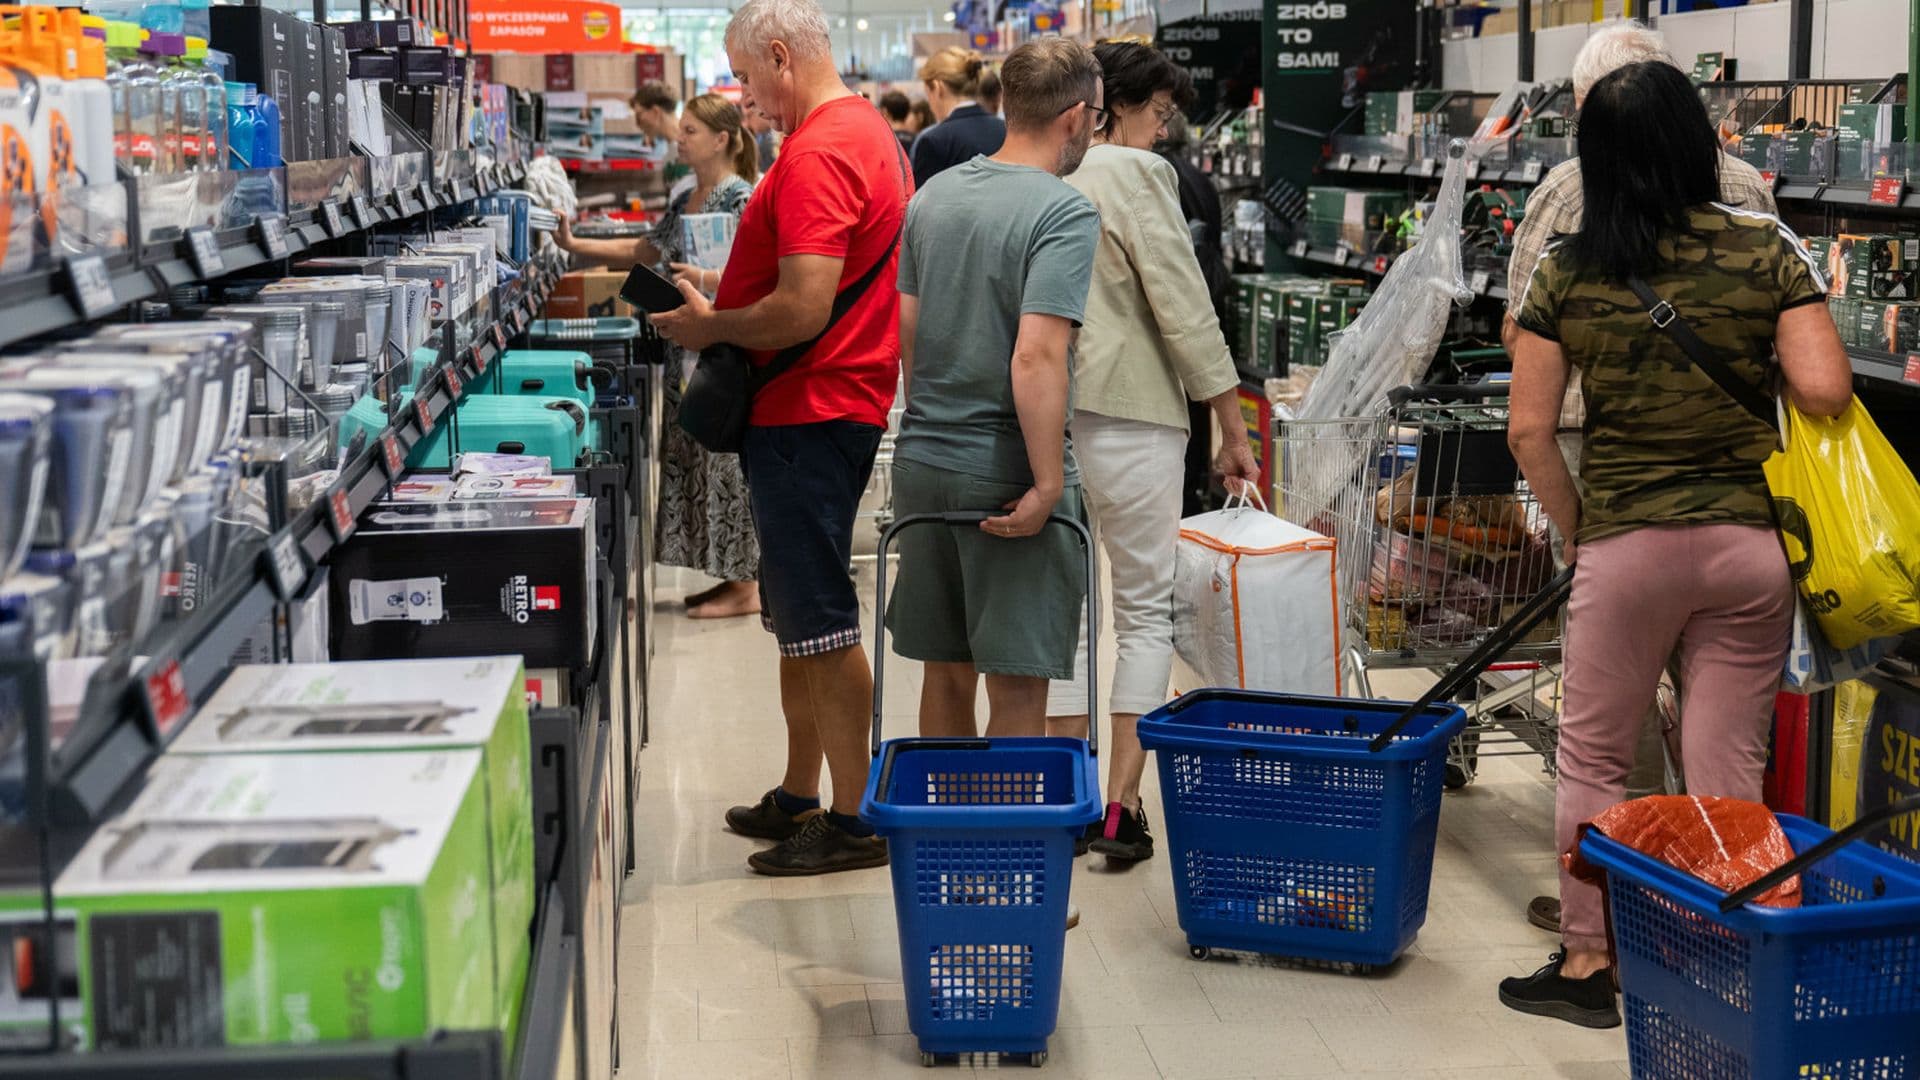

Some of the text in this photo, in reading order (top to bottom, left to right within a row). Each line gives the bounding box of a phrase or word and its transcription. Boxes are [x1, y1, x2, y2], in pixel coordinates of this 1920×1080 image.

[486, 12, 569, 23] WYCZERPANIA
[1277, 2, 1346, 19] ZRÓB
[490, 25, 546, 37] ZAPASÓW
[1163, 27, 1219, 41] ZRÓB
[1277, 29, 1312, 43] TO
[1165, 48, 1192, 60] TO
[1277, 52, 1340, 68] SAM!
[1181, 67, 1213, 80] AM!
[515, 575, 529, 623] RETRO
